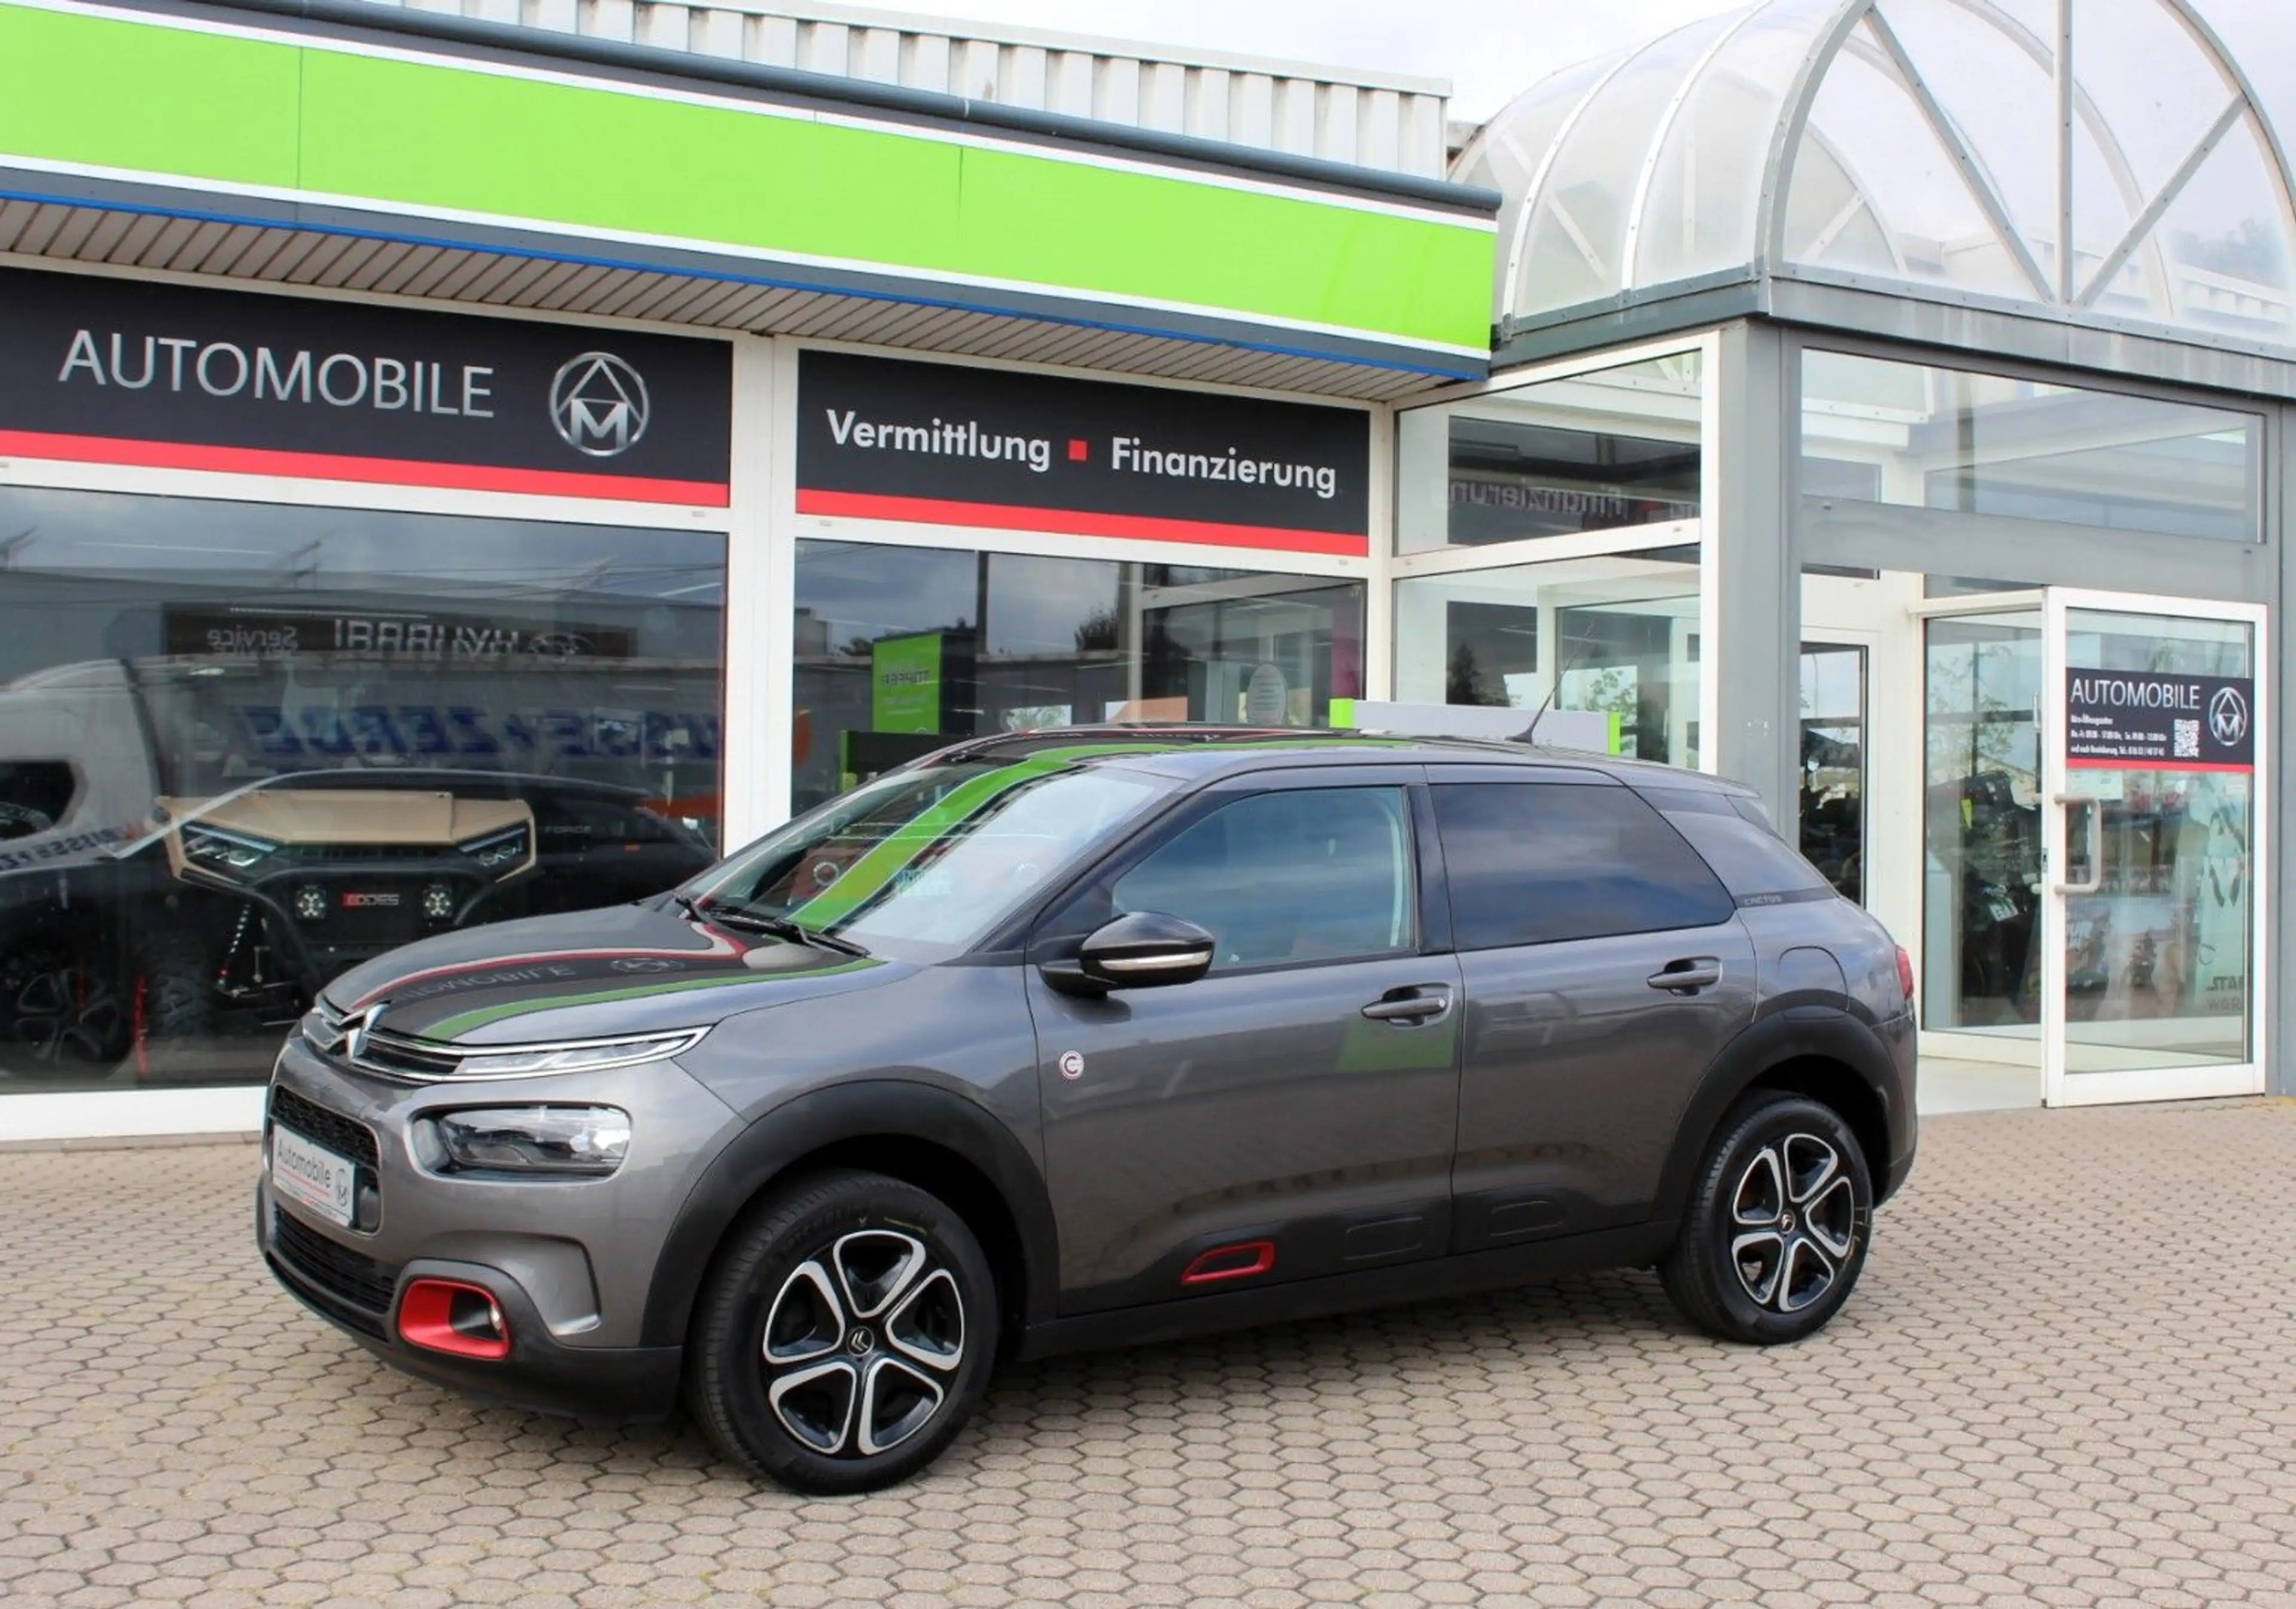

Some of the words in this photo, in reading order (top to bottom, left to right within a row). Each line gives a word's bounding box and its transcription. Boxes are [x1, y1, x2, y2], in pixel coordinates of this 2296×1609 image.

[57, 329, 494, 418] AUTOMOBILE
[826, 409, 1051, 473] Vermittlung
[1111, 436, 1336, 499] Finanzierung
[2070, 678, 2201, 710] AUTOMOBILE
[1744, 895, 1782, 906] CACTUS
